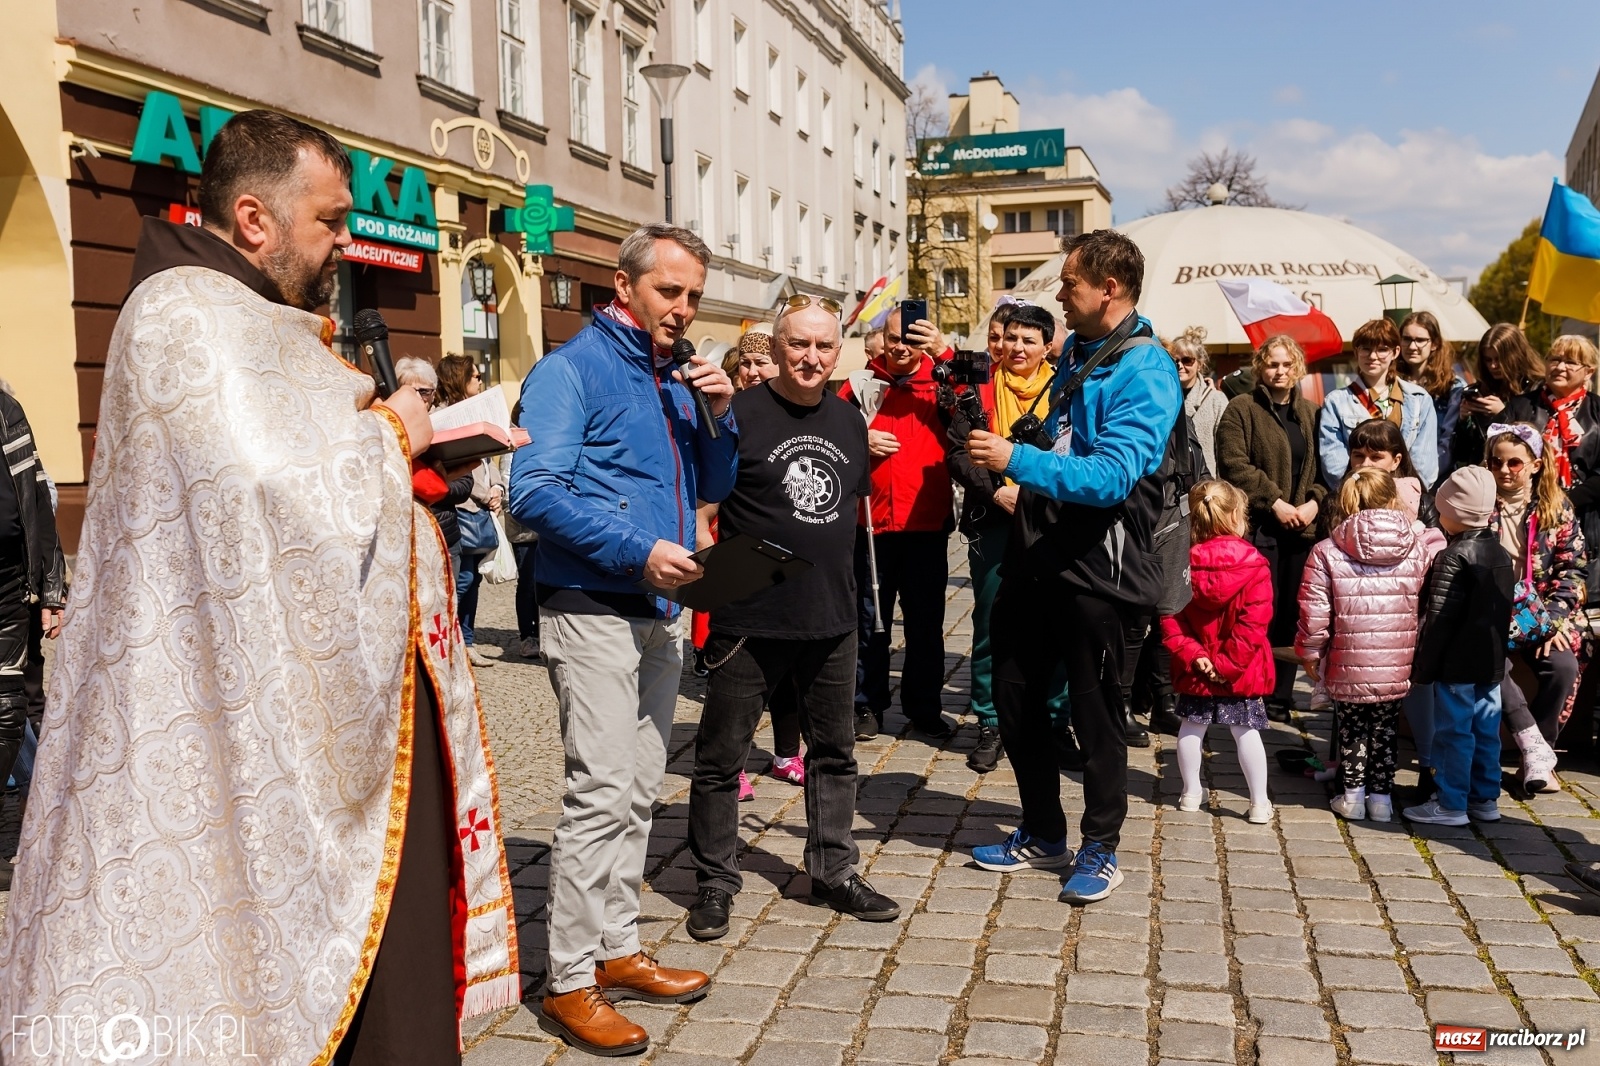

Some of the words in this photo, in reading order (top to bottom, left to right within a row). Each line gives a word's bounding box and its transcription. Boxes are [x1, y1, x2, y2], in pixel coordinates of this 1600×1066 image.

[953, 145, 1027, 161] McDonald's
[356, 218, 385, 235] POD
[388, 222, 436, 247] RÓŻAMI
[1172, 262, 1276, 285] BROWAR
[767, 453, 777, 463] 25
[772, 435, 824, 456] ROZPOCZĘCIE
[824, 440, 850, 464] SEZONU
[780, 443, 838, 462] MOTOCYKLOWEGO
[792, 509, 825, 524] Racibórz
